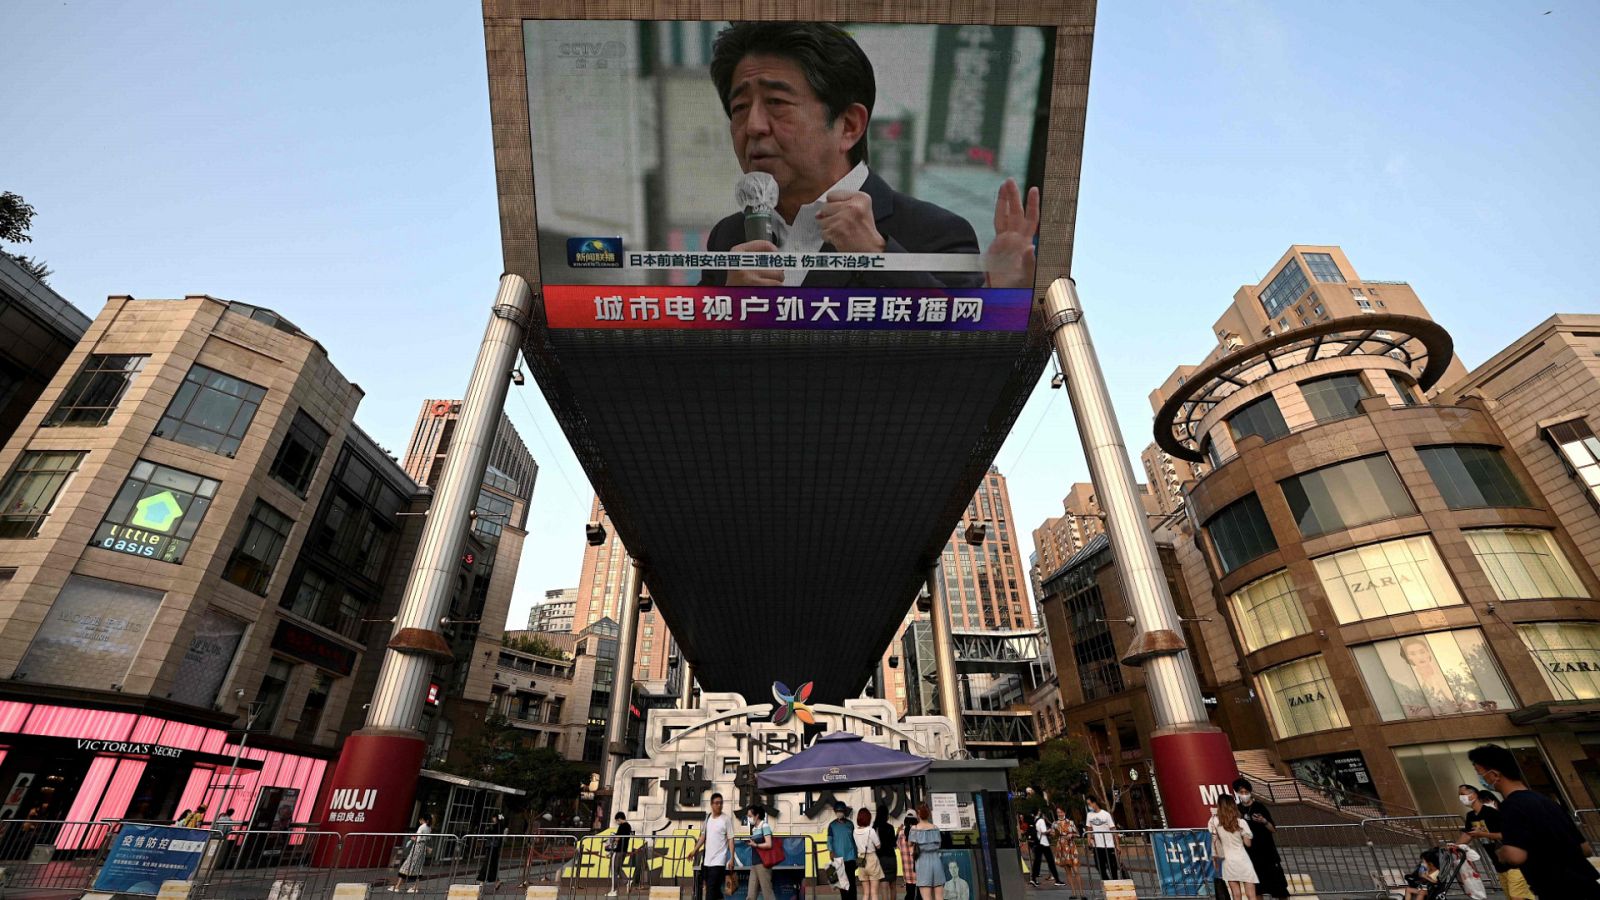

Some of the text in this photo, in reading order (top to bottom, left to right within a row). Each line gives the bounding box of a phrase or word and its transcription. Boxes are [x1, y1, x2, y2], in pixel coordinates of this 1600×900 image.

[630, 254, 885, 268] 日本前首相安倍晋三遭枪击 伤重不治身亡
[594, 295, 984, 323] 城市电视户外大屏联播网
[1351, 575, 1413, 593] ZARA
[1549, 661, 1600, 673] ZARA
[1289, 691, 1325, 707] ZARA
[77, 739, 183, 758] VICTORIA'S SECRET
[329, 788, 377, 810] MUJI
[328, 812, 365, 822] 無印良品
[121, 835, 170, 850] 疫情防控
[1163, 841, 1209, 863] 出口
